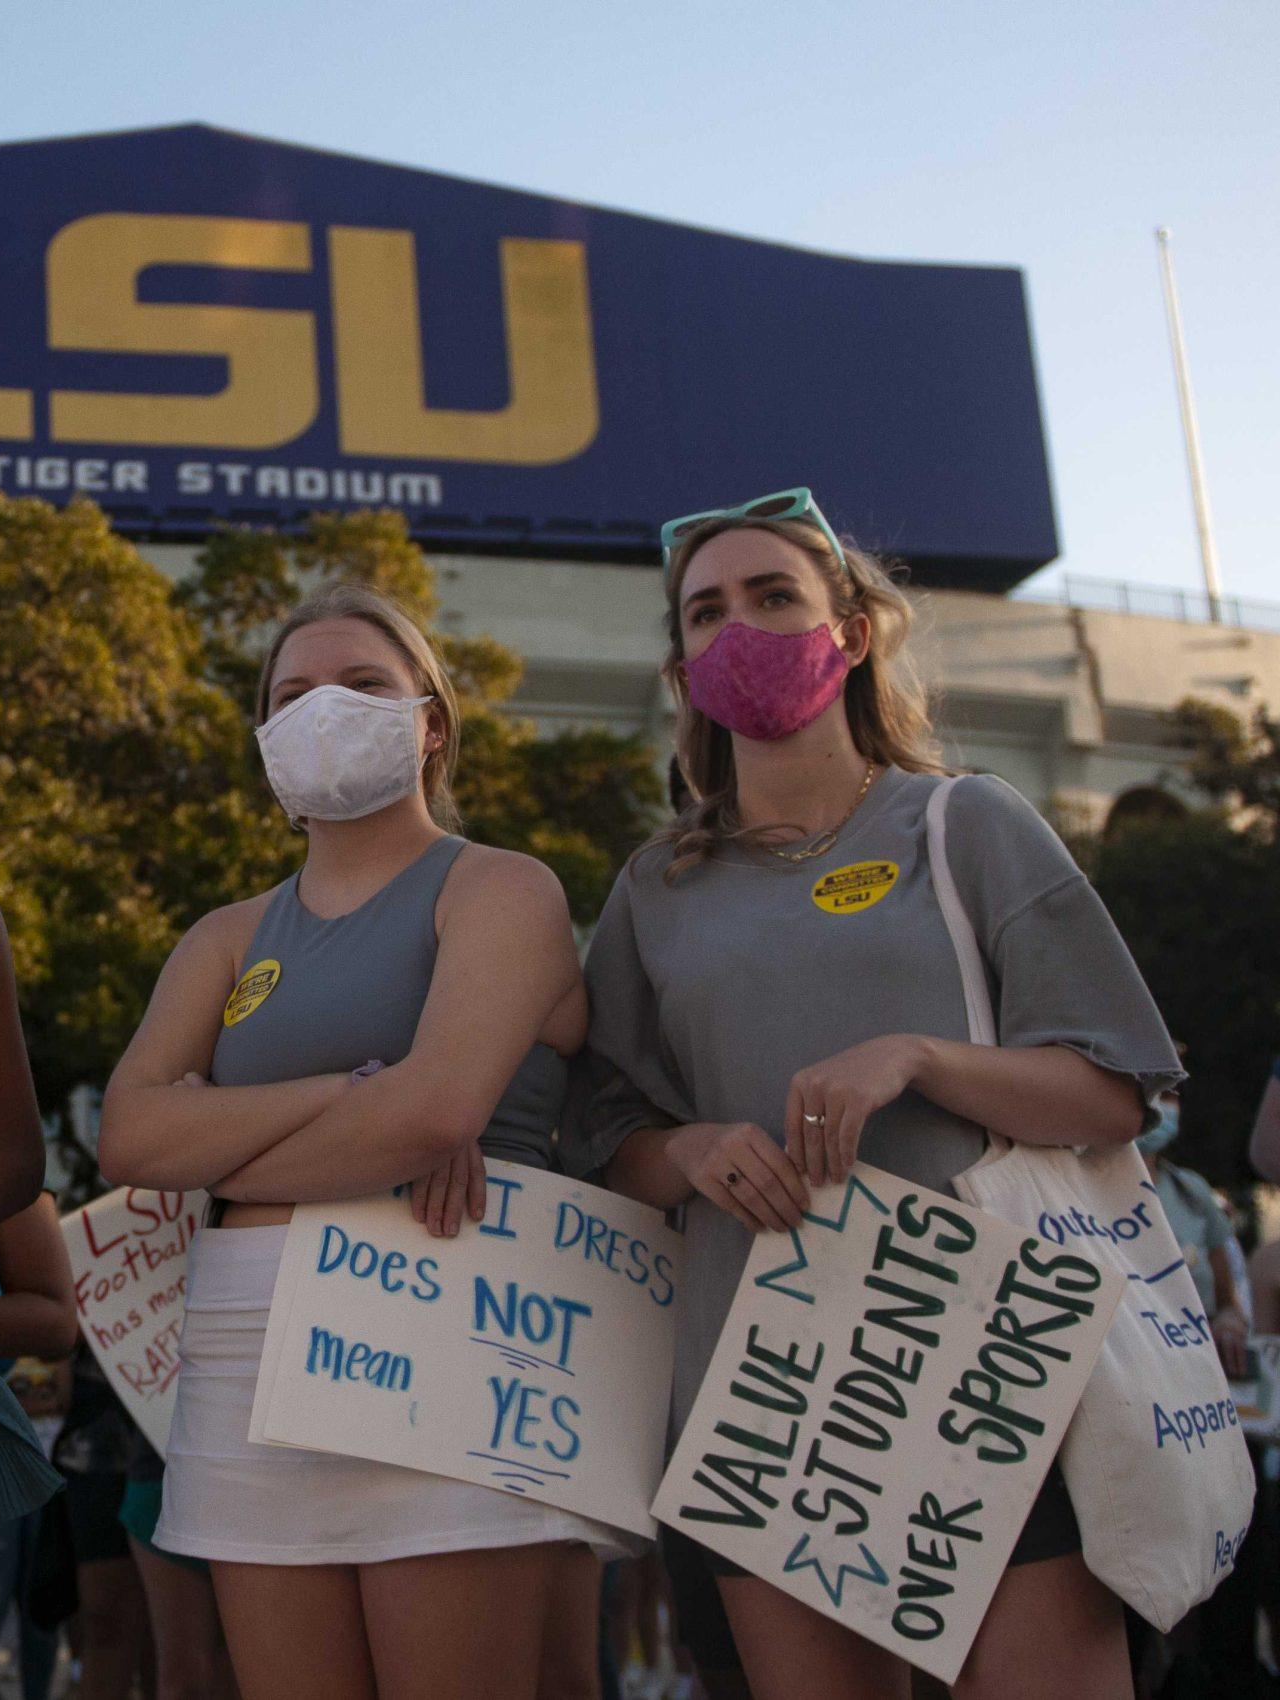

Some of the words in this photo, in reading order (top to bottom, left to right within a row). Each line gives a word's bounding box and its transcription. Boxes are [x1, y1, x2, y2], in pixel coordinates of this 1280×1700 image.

[177, 461, 443, 505] STADIUM
[833, 891, 871, 907] LSU
[82, 1187, 185, 1259] LSU
[479, 1175, 524, 1239] I
[553, 1200, 676, 1307] DRESS
[90, 1313, 144, 1350] has
[472, 1275, 592, 1367] NOT
[791, 1193, 978, 1536] STUDENTS
[937, 1236, 1102, 1465] SPORTS
[304, 1325, 414, 1392] mean
[488, 1375, 582, 1463] YES
[678, 1324, 825, 1530] VALUE
[891, 1490, 984, 1642] OVER
